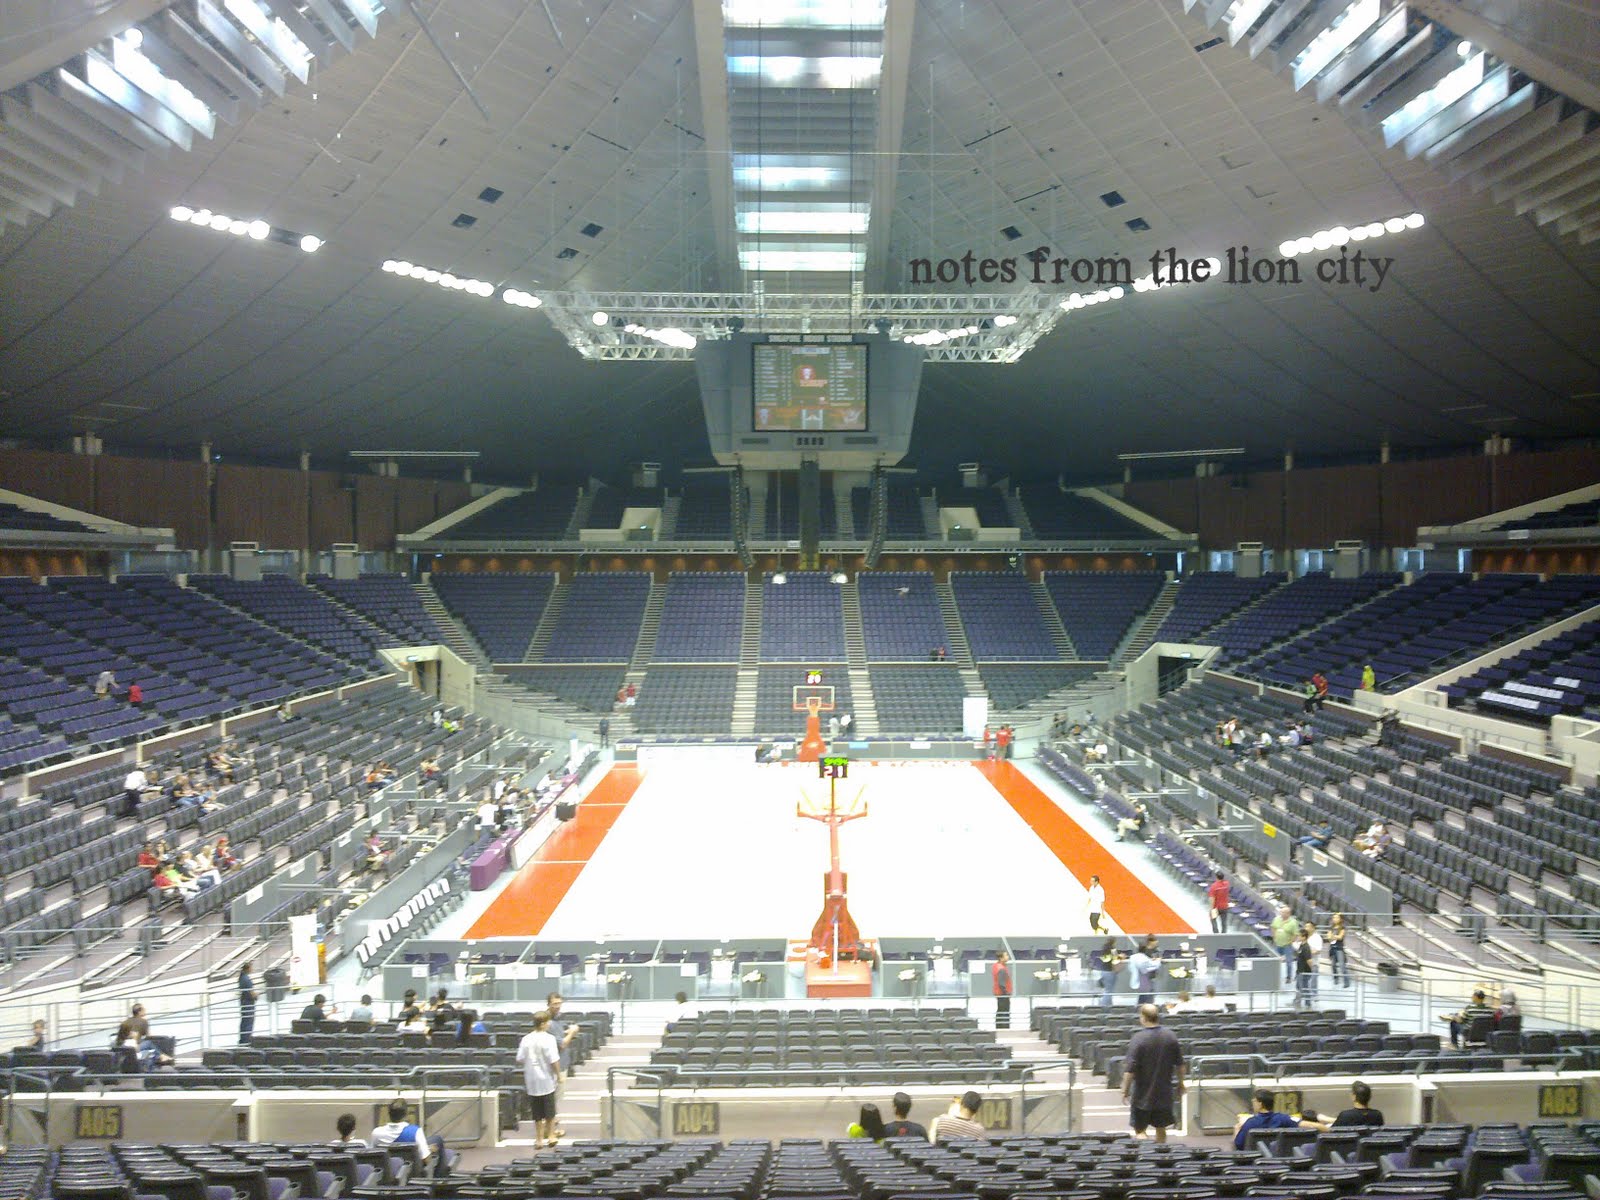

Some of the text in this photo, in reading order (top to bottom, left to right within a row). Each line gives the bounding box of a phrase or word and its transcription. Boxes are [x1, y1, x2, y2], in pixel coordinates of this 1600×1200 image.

[1541, 1087, 1578, 1115] A03
[78, 1107, 120, 1137] A05
[676, 1103, 716, 1133] A04
